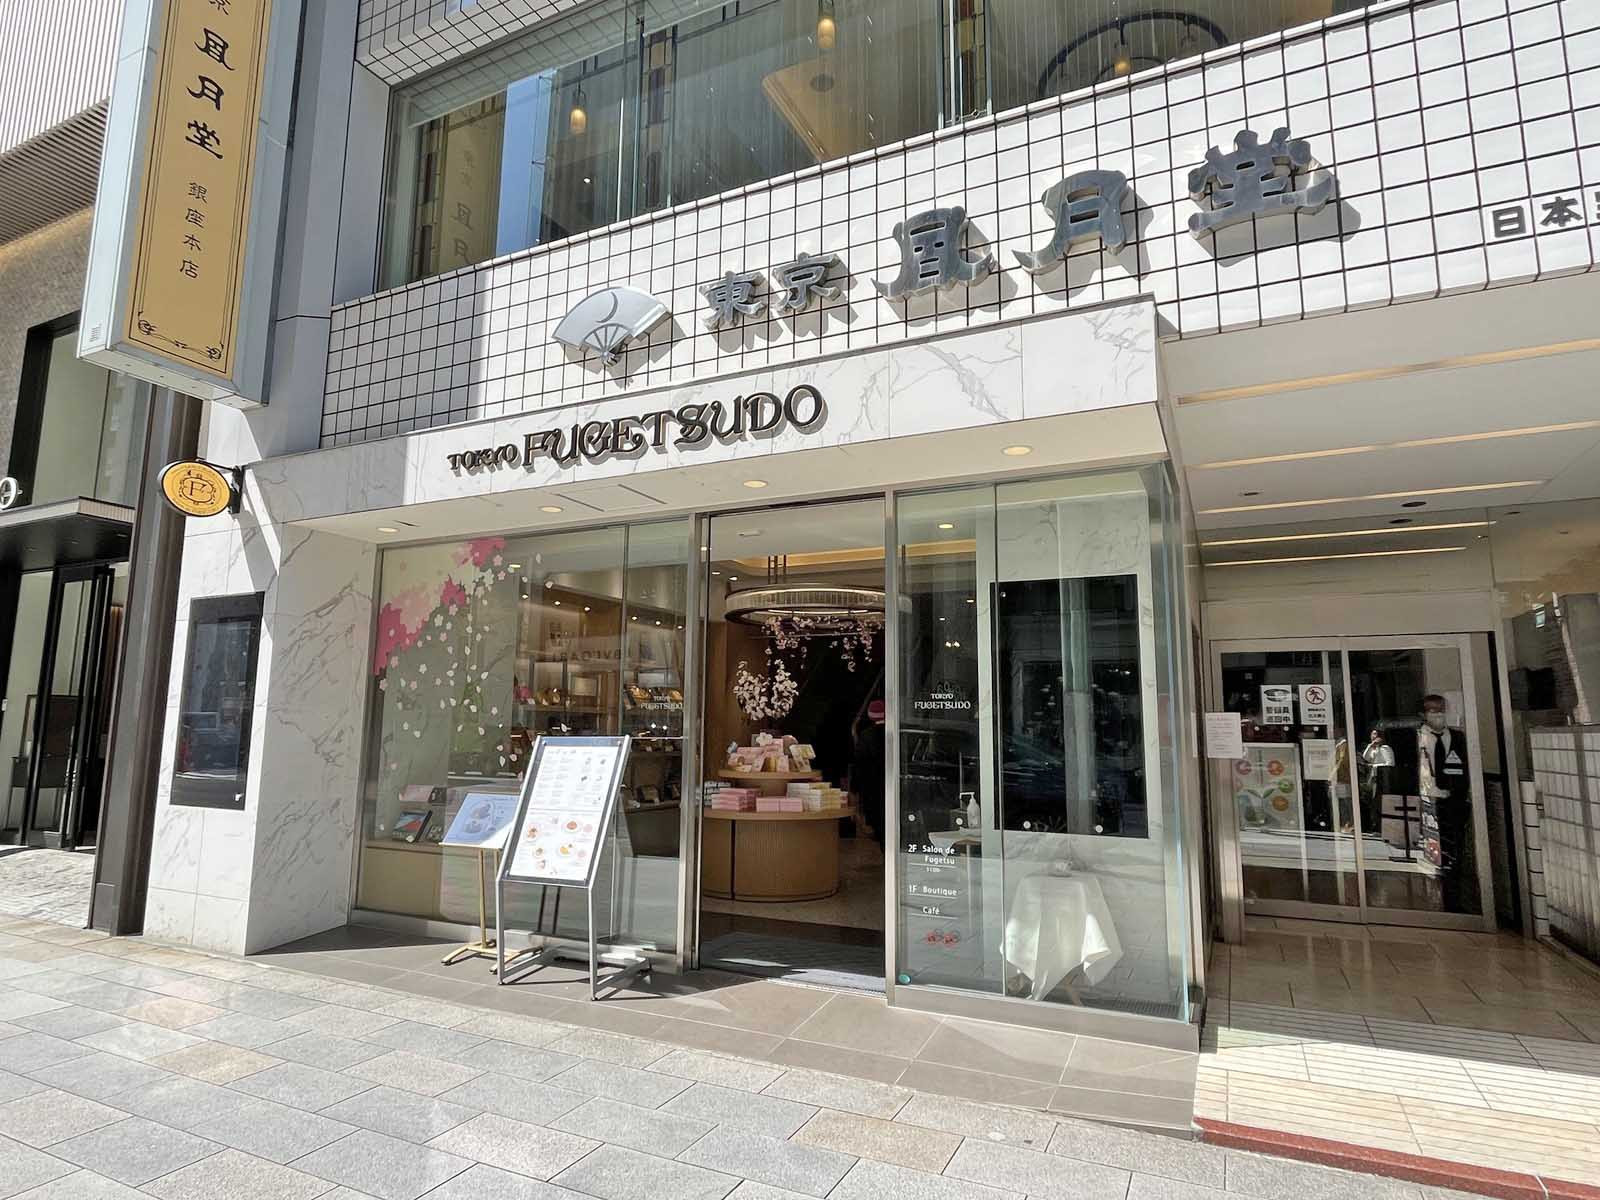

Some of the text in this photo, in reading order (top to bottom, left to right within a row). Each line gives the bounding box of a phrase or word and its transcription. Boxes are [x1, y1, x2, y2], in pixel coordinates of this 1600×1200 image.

[1492, 190, 1600, 238] 日本
[180, 182, 208, 279] 銀座本店
[447, 383, 826, 471] TOKYO FUGETSUDO
[914, 700, 971, 710] FUGETSUDO
[907, 843, 956, 855] 2F Salon de
[924, 855, 956, 865] Fugetsu
[922, 886, 958, 897] Boutique
[922, 905, 942, 915] Café
